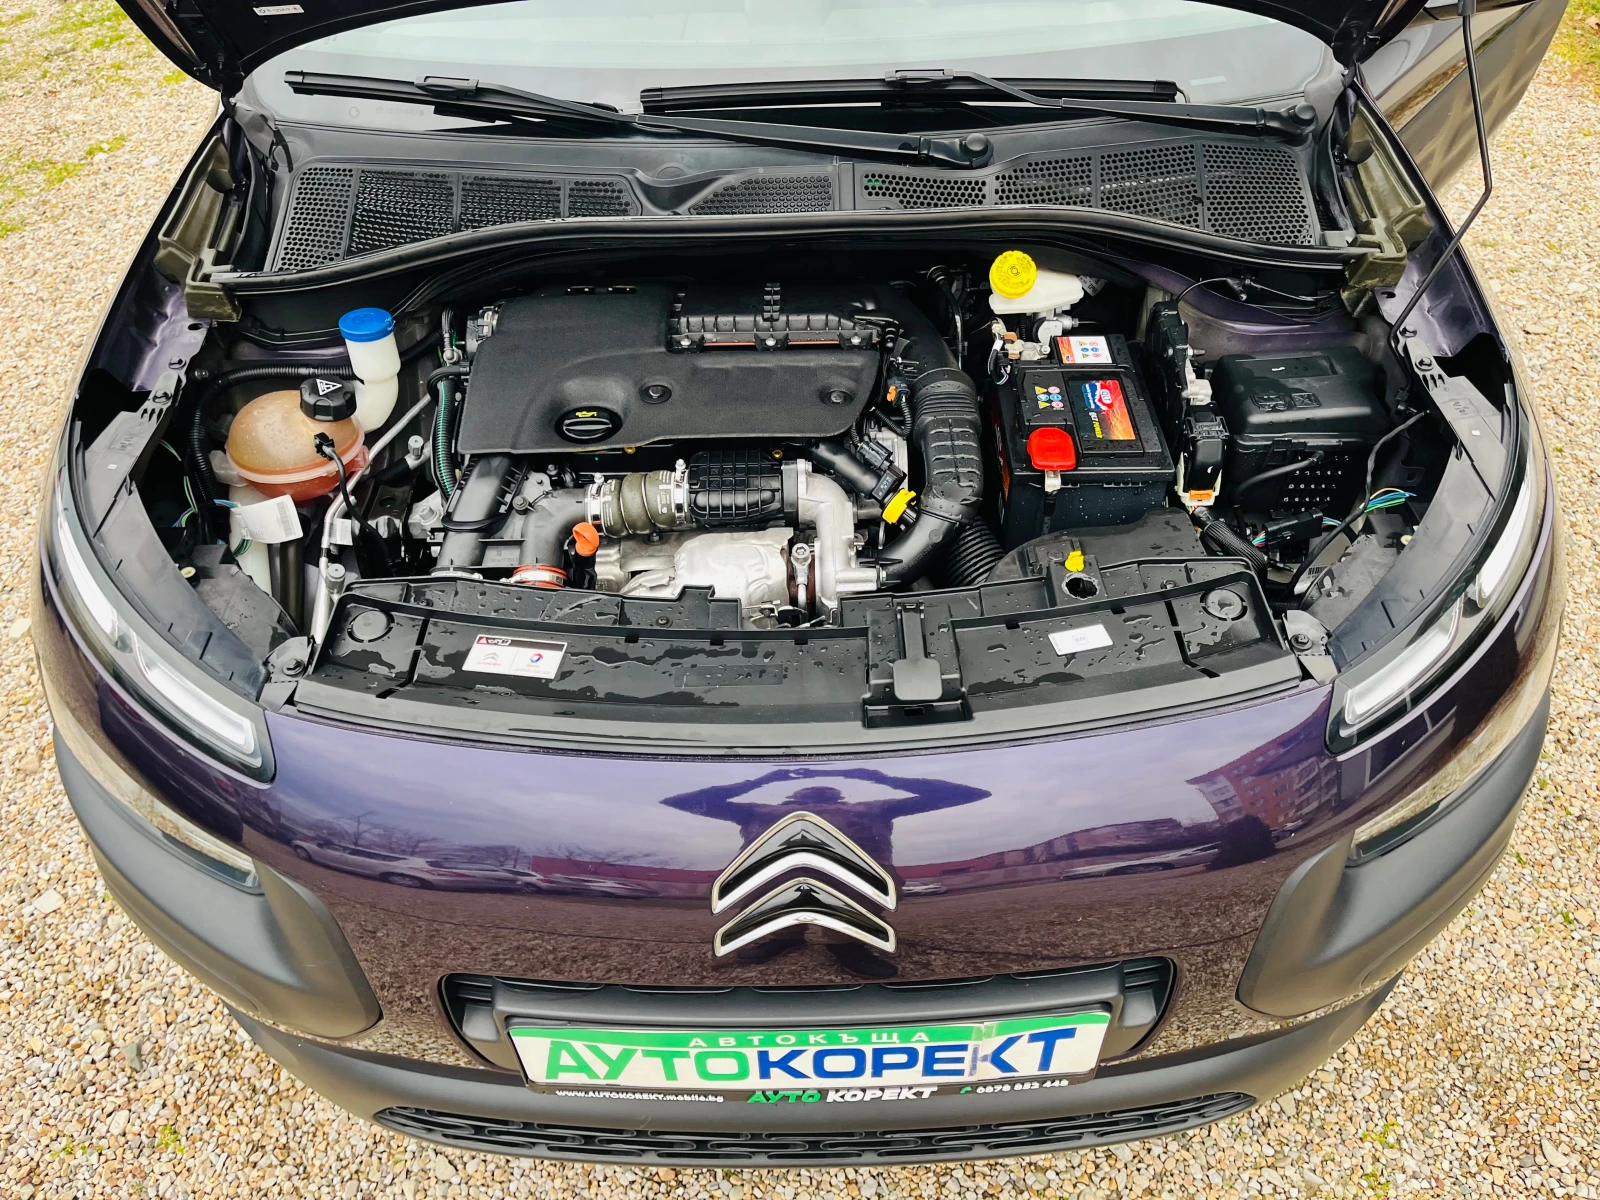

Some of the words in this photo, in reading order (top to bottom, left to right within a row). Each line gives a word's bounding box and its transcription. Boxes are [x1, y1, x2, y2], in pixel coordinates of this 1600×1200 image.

[688, 1031, 930, 1048] АВТОКЪЩА
[545, 1027, 1077, 1081] АУТОКОРЕКТ
[747, 1089, 822, 1104] АУТО
[826, 1085, 938, 1103] КОРЕКТ
